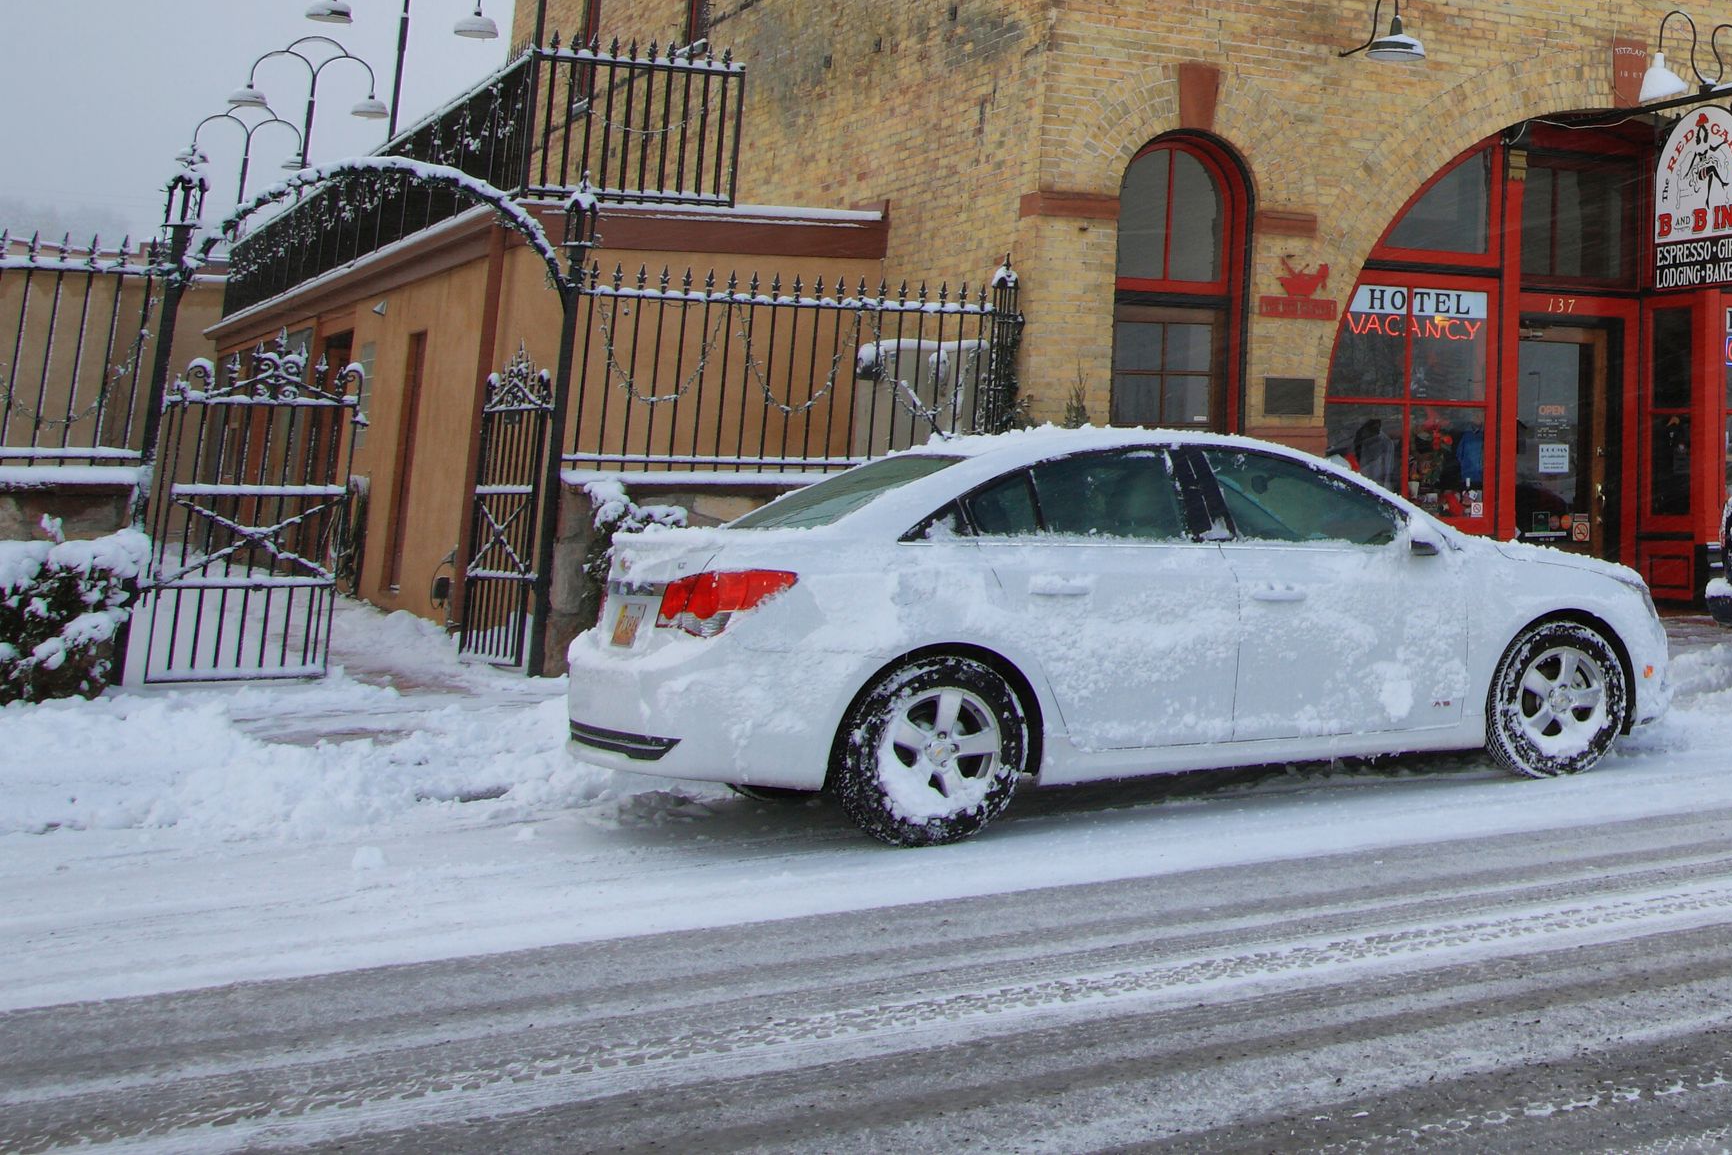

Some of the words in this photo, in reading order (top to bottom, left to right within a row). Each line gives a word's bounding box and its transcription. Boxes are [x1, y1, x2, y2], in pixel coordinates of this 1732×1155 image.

[1667, 130, 1694, 173] RED
[1658, 213, 1672, 238] B
[1675, 216, 1691, 226] AND
[1692, 208, 1708, 232] B
[1656, 242, 1712, 266] ESPRESSO
[1656, 266, 1700, 288] LODGING
[1368, 288, 1470, 316] HOTEL
[1548, 298, 1576, 314] 137
[1348, 313, 1481, 340] VACANCY
[1538, 405, 1565, 416] OPEN
